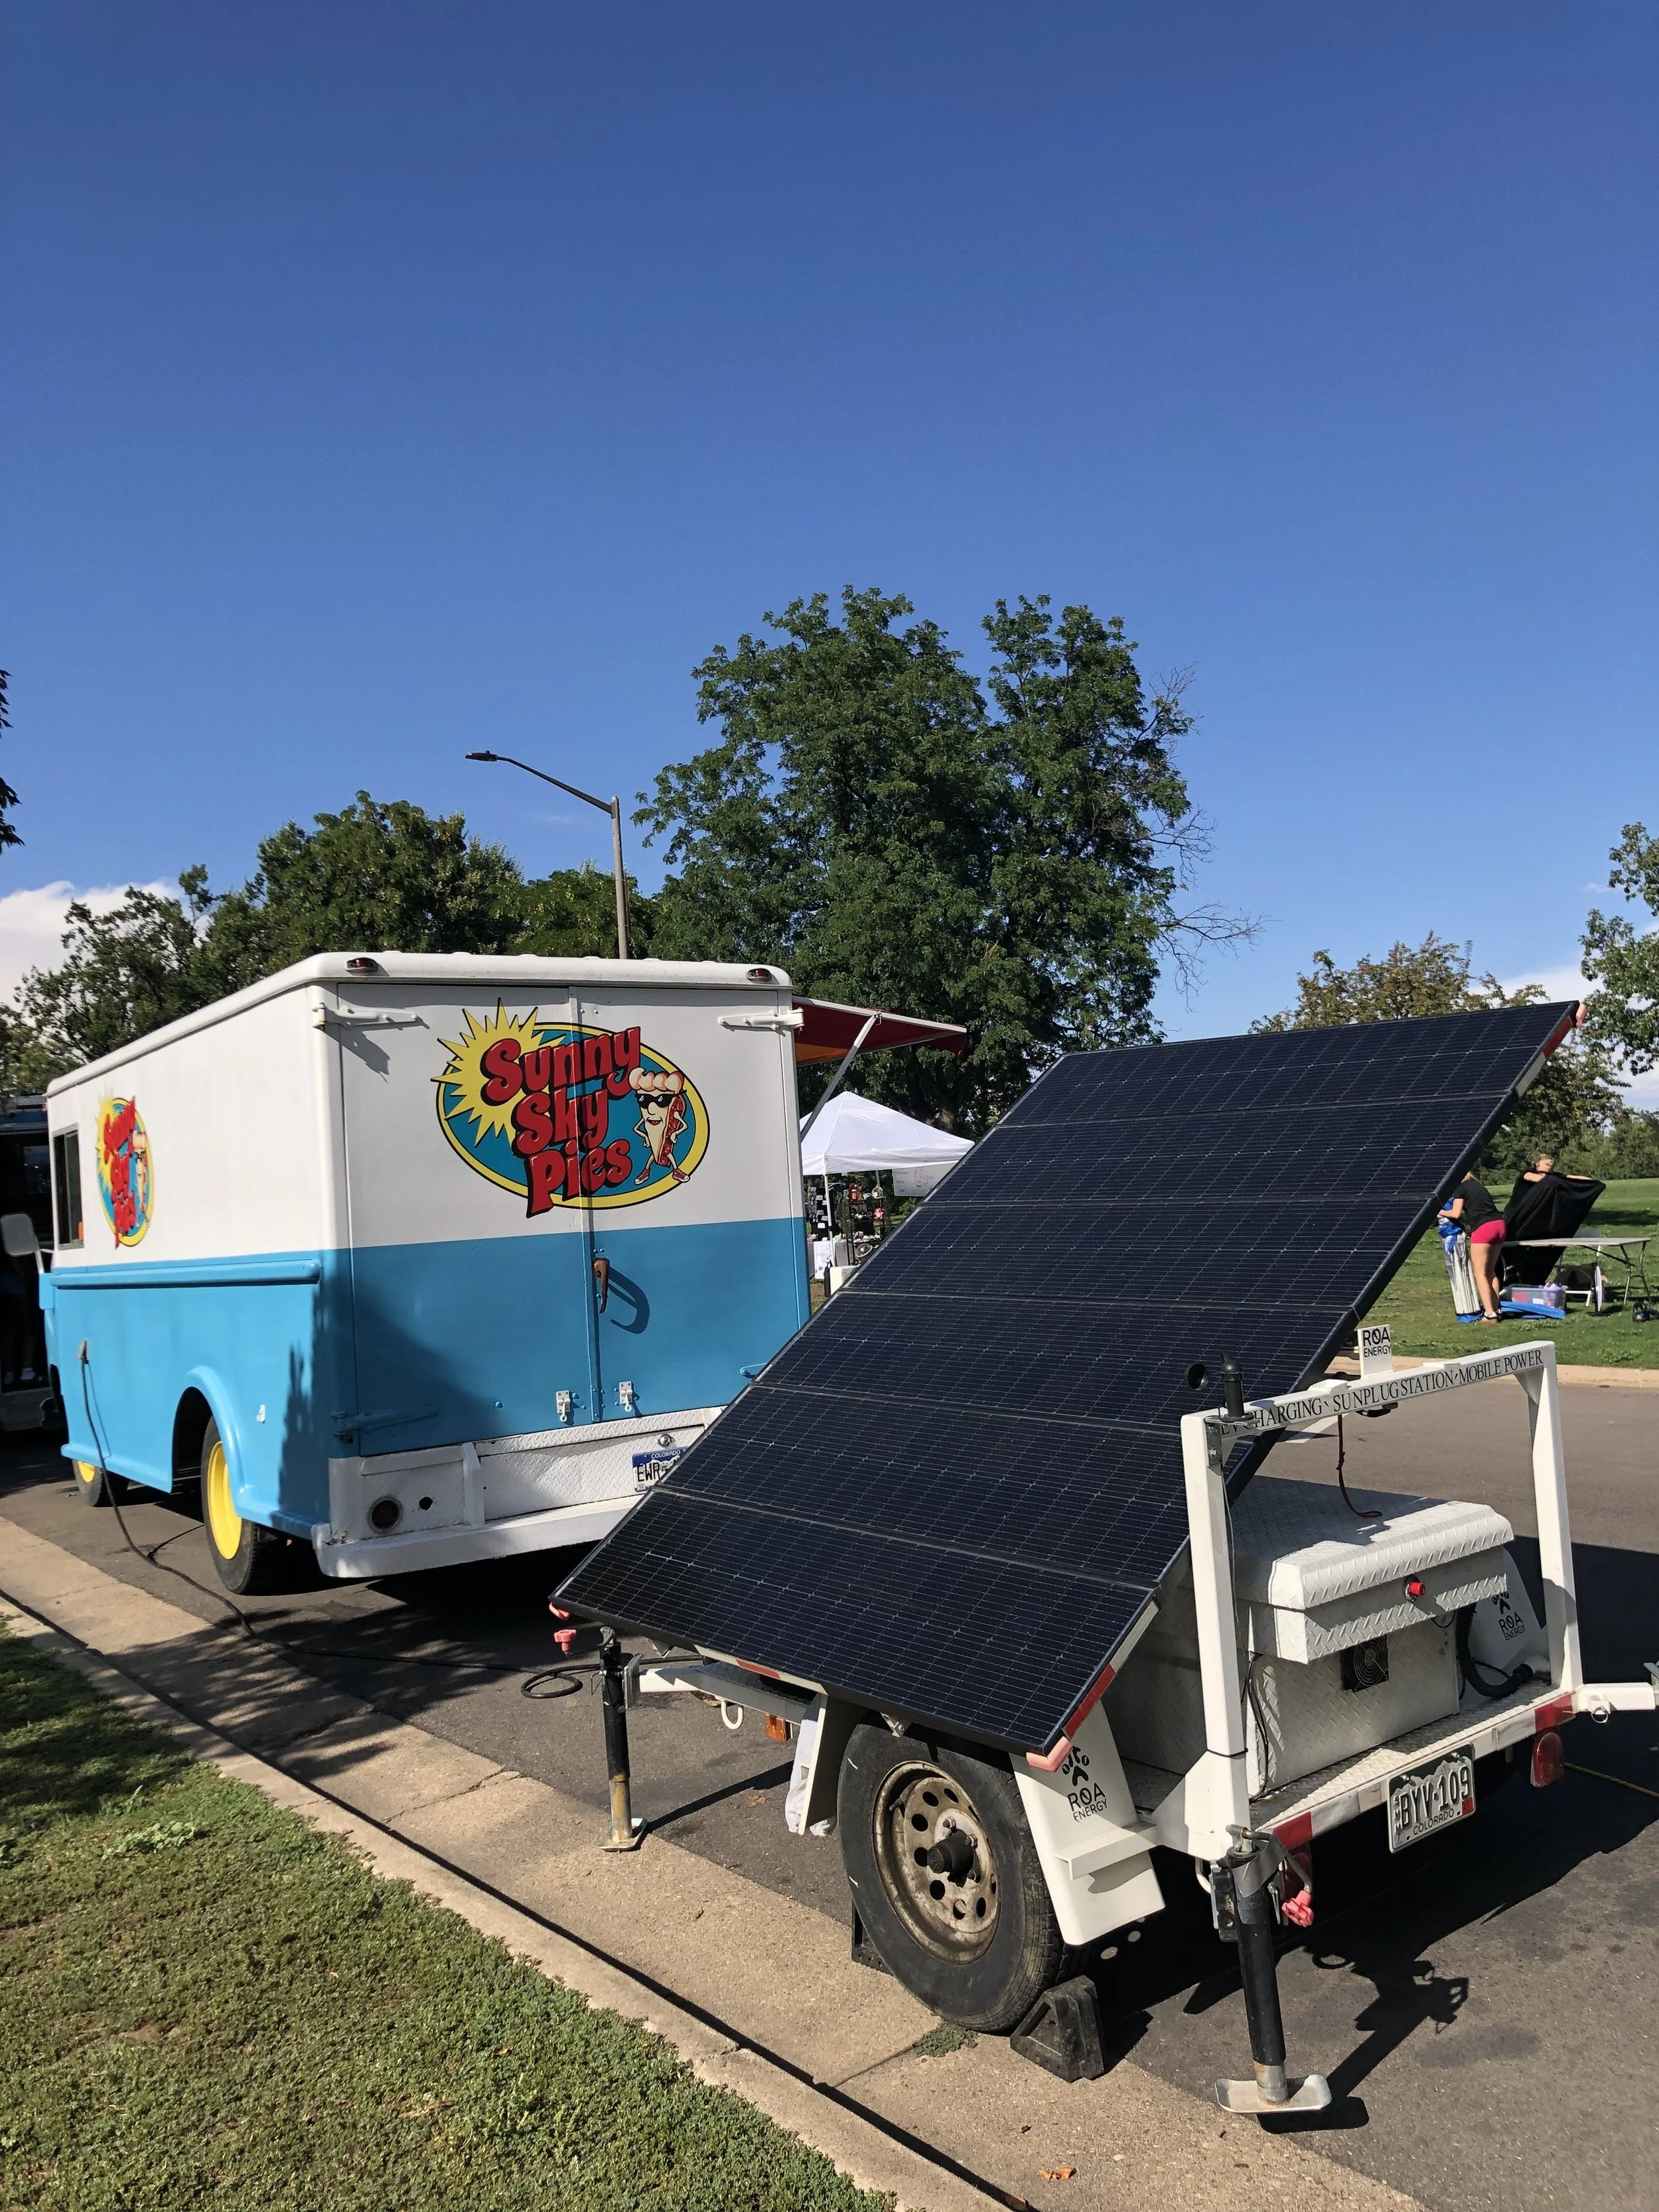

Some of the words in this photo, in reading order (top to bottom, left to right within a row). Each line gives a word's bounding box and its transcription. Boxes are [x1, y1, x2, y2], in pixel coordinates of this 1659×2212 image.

[480, 1027, 640, 1106] Sunny
[512, 1086, 609, 1157] Sky
[526, 1139, 632, 1218] Pies
[1363, 1327, 1391, 1347] ROA
[1364, 1344, 1391, 1357] ENERGY
[1243, 1398, 1322, 1430] HARGING
[1504, 1350, 1543, 1372] POWER
[651, 1449, 681, 1459] COLORADO
[1498, 1612, 1524, 1633] ROA
[1504, 1624, 1526, 1641] ENERGY
[1068, 1783, 1106, 1812] ROA
[1073, 1798, 1108, 1823] ENERGY
[1413, 1808, 1455, 1836] COLORADO
